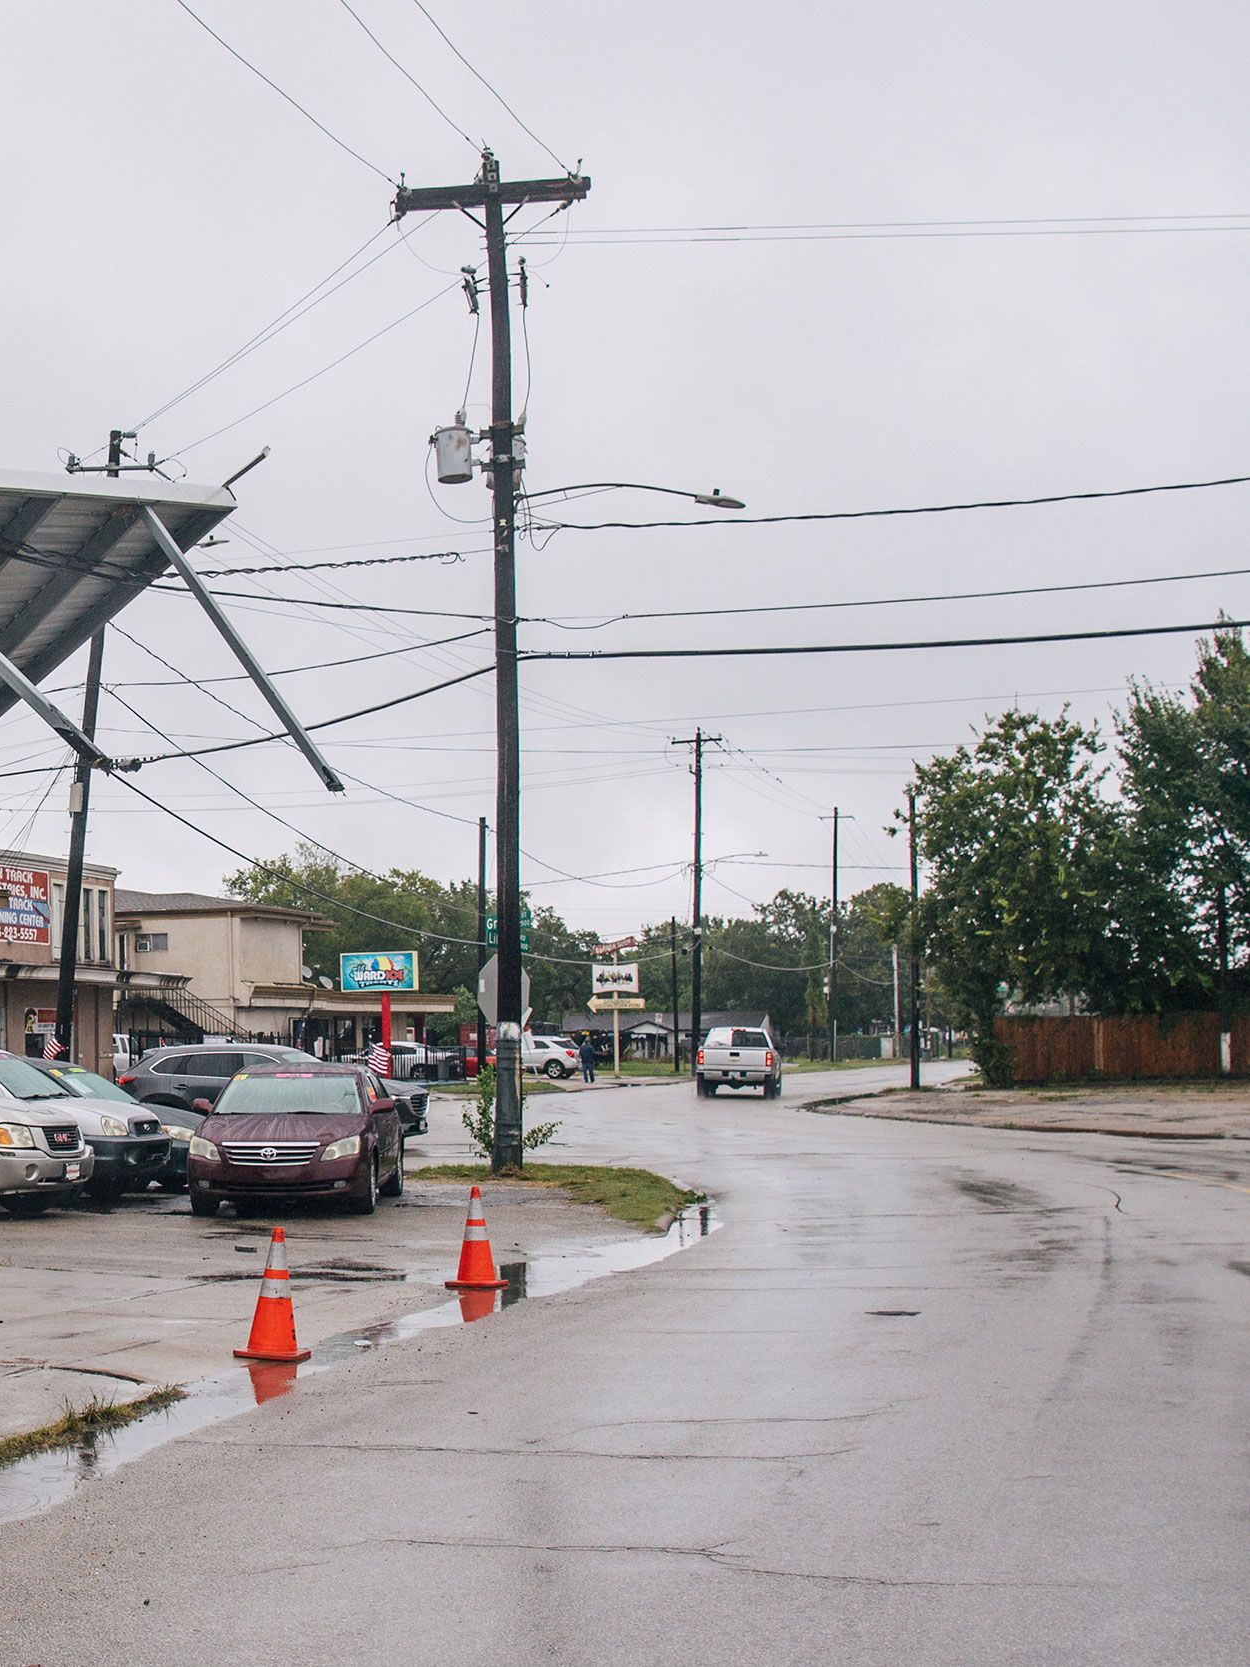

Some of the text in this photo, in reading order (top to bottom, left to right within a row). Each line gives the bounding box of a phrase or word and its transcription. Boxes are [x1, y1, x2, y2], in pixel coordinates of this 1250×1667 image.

[5, 868, 34, 884] TRACK
[30, 885, 47, 900] INC.
[8, 896, 33, 911] TRACK
[19, 912, 44, 928] CENTER
[353, 970, 386, 981] WARD
